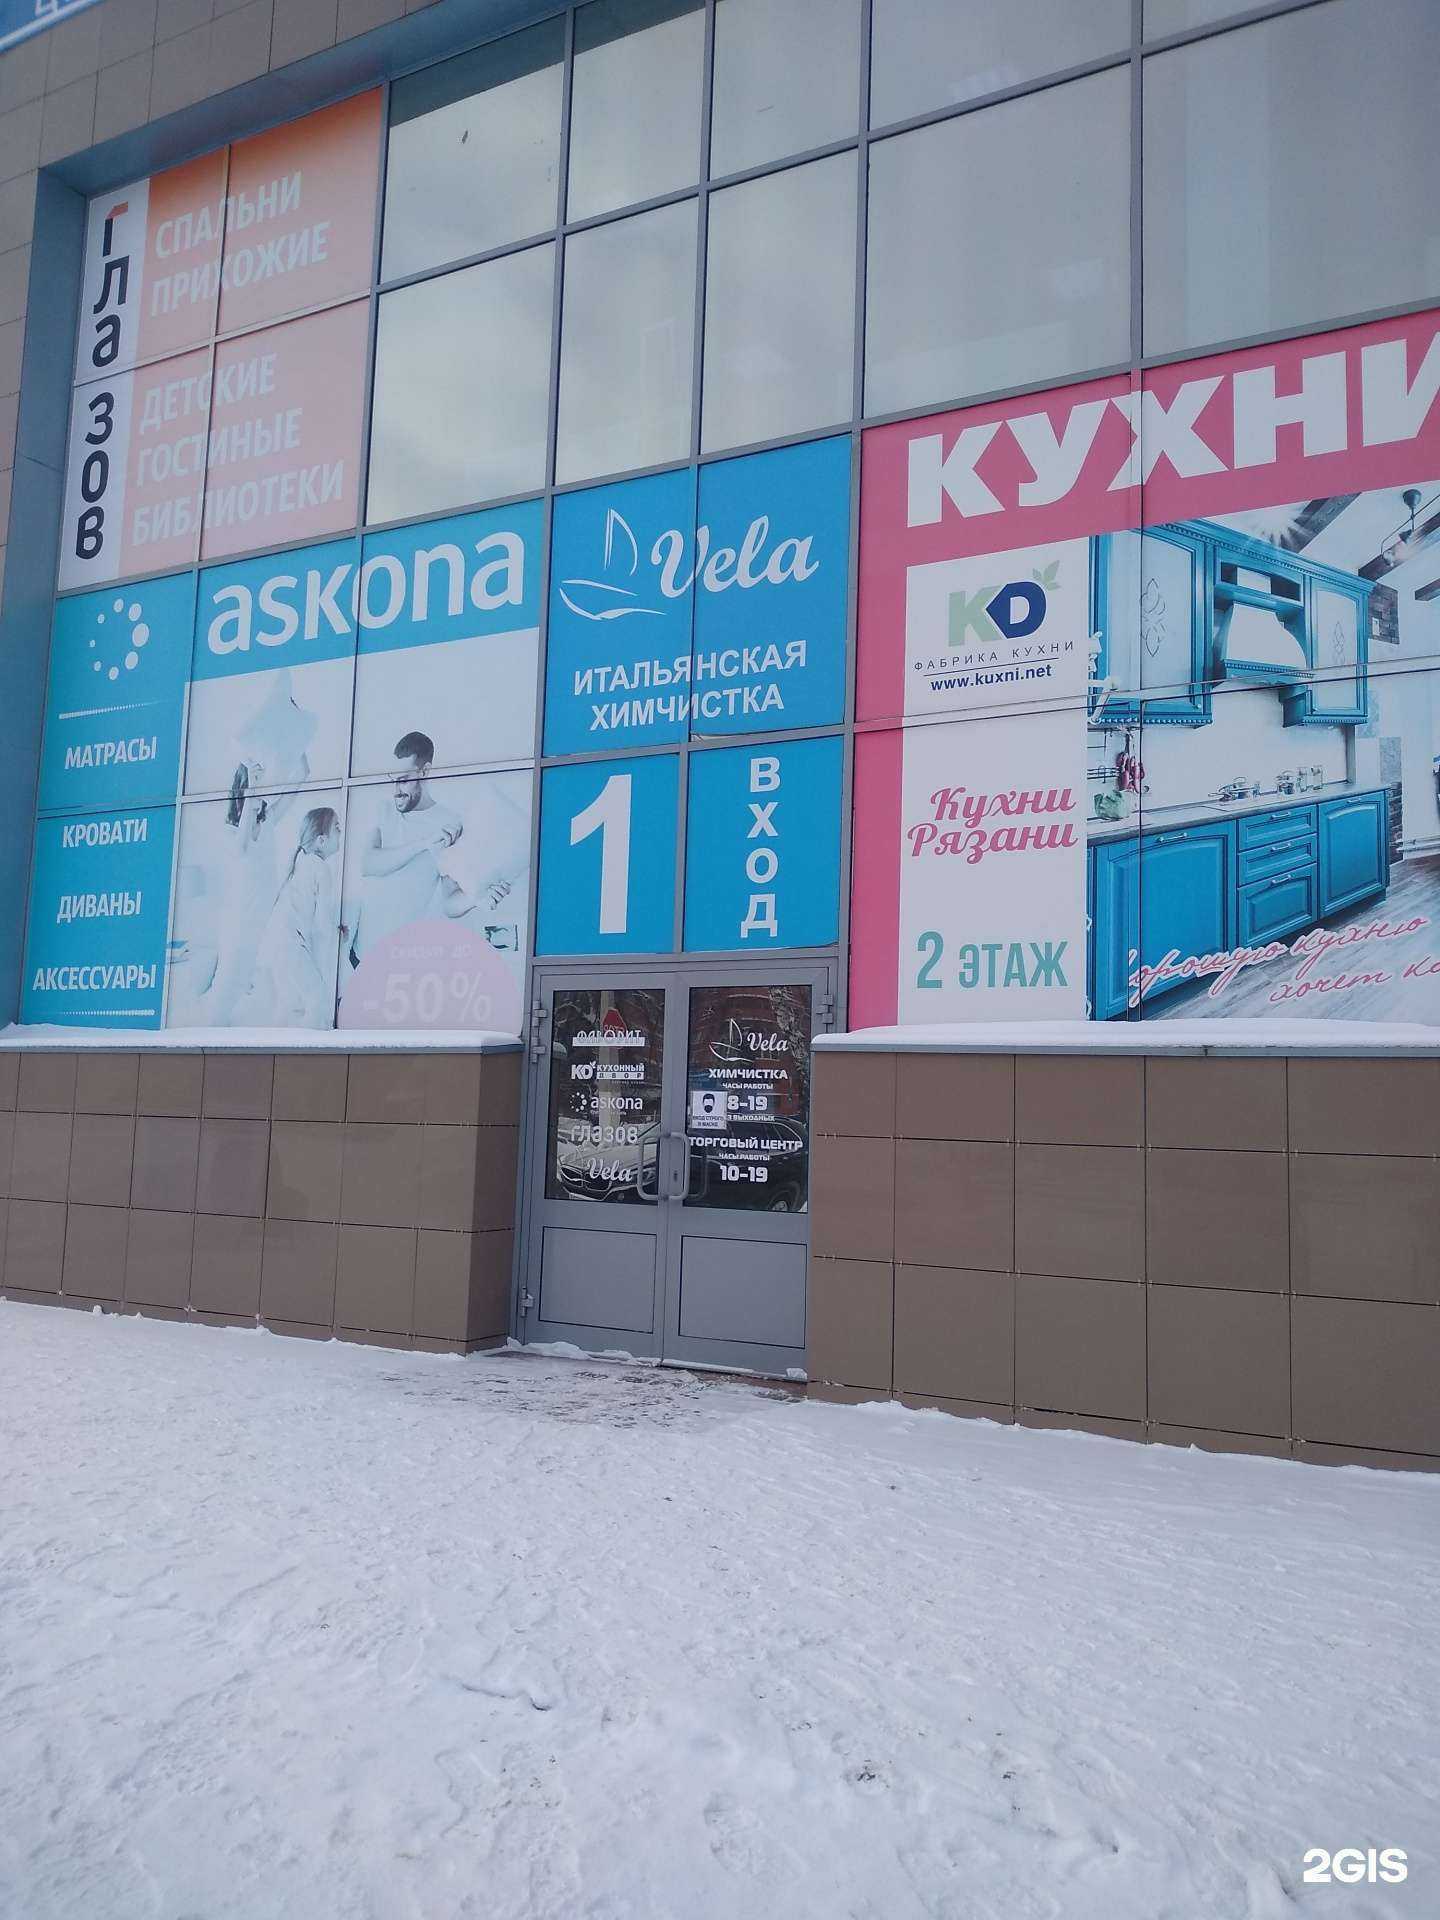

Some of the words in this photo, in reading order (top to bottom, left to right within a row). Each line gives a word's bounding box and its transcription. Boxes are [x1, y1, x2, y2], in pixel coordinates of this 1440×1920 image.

[156, 170, 301, 258] СПАЛЬНИ
[151, 221, 331, 317] ПРИХОЖИЕ
[140, 353, 276, 434] ДЕТСКИЕ
[137, 407, 302, 487] ГОСТИНЫЕ
[907, 331, 1440, 528] КУХНИ
[132, 459, 344, 546] БИБЛИОТЕКИ
[651, 515, 819, 598] Vela
[207, 531, 525, 654] askona
[573, 640, 808, 695] ИТАЛЬЯНСКАЯ
[914, 652, 998, 671] ФАБРИКА
[1012, 641, 1074, 658] КУХНИ
[931, 664, 1052, 691] www.kuxni.net
[590, 683, 785, 731] ХИМЧИСТКА
[64, 736, 157, 769] МАТРАСЫ
[930, 787, 1077, 828] Кухни
[62, 818, 148, 848] КРОВАТИ
[740, 757, 781, 938] ВХОД
[907, 822, 1079, 864] Рязани
[570, 774, 631, 935] 1
[57, 891, 142, 923] ДИВАНЫ
[32, 964, 157, 991] АКСЕССУАРЫ
[917, 931, 944, 988] 2
[959, 941, 1068, 988] ЭТАЖ
[747, 1032, 789, 1051] Vela
[597, 1062, 644, 1071] КУХОННЫЙ
[708, 1068, 788, 1079] ХИМЧИСТКА
[591, 1097, 643, 1110] askona
[727, 1095, 768, 1111] 8-19
[689, 1137, 757, 1149] ТОРГОВЫЙ
[761, 1139, 803, 1151] ЦЕНТР
[587, 1158, 633, 1181] Vela
[720, 1165, 768, 1183] 10-19
